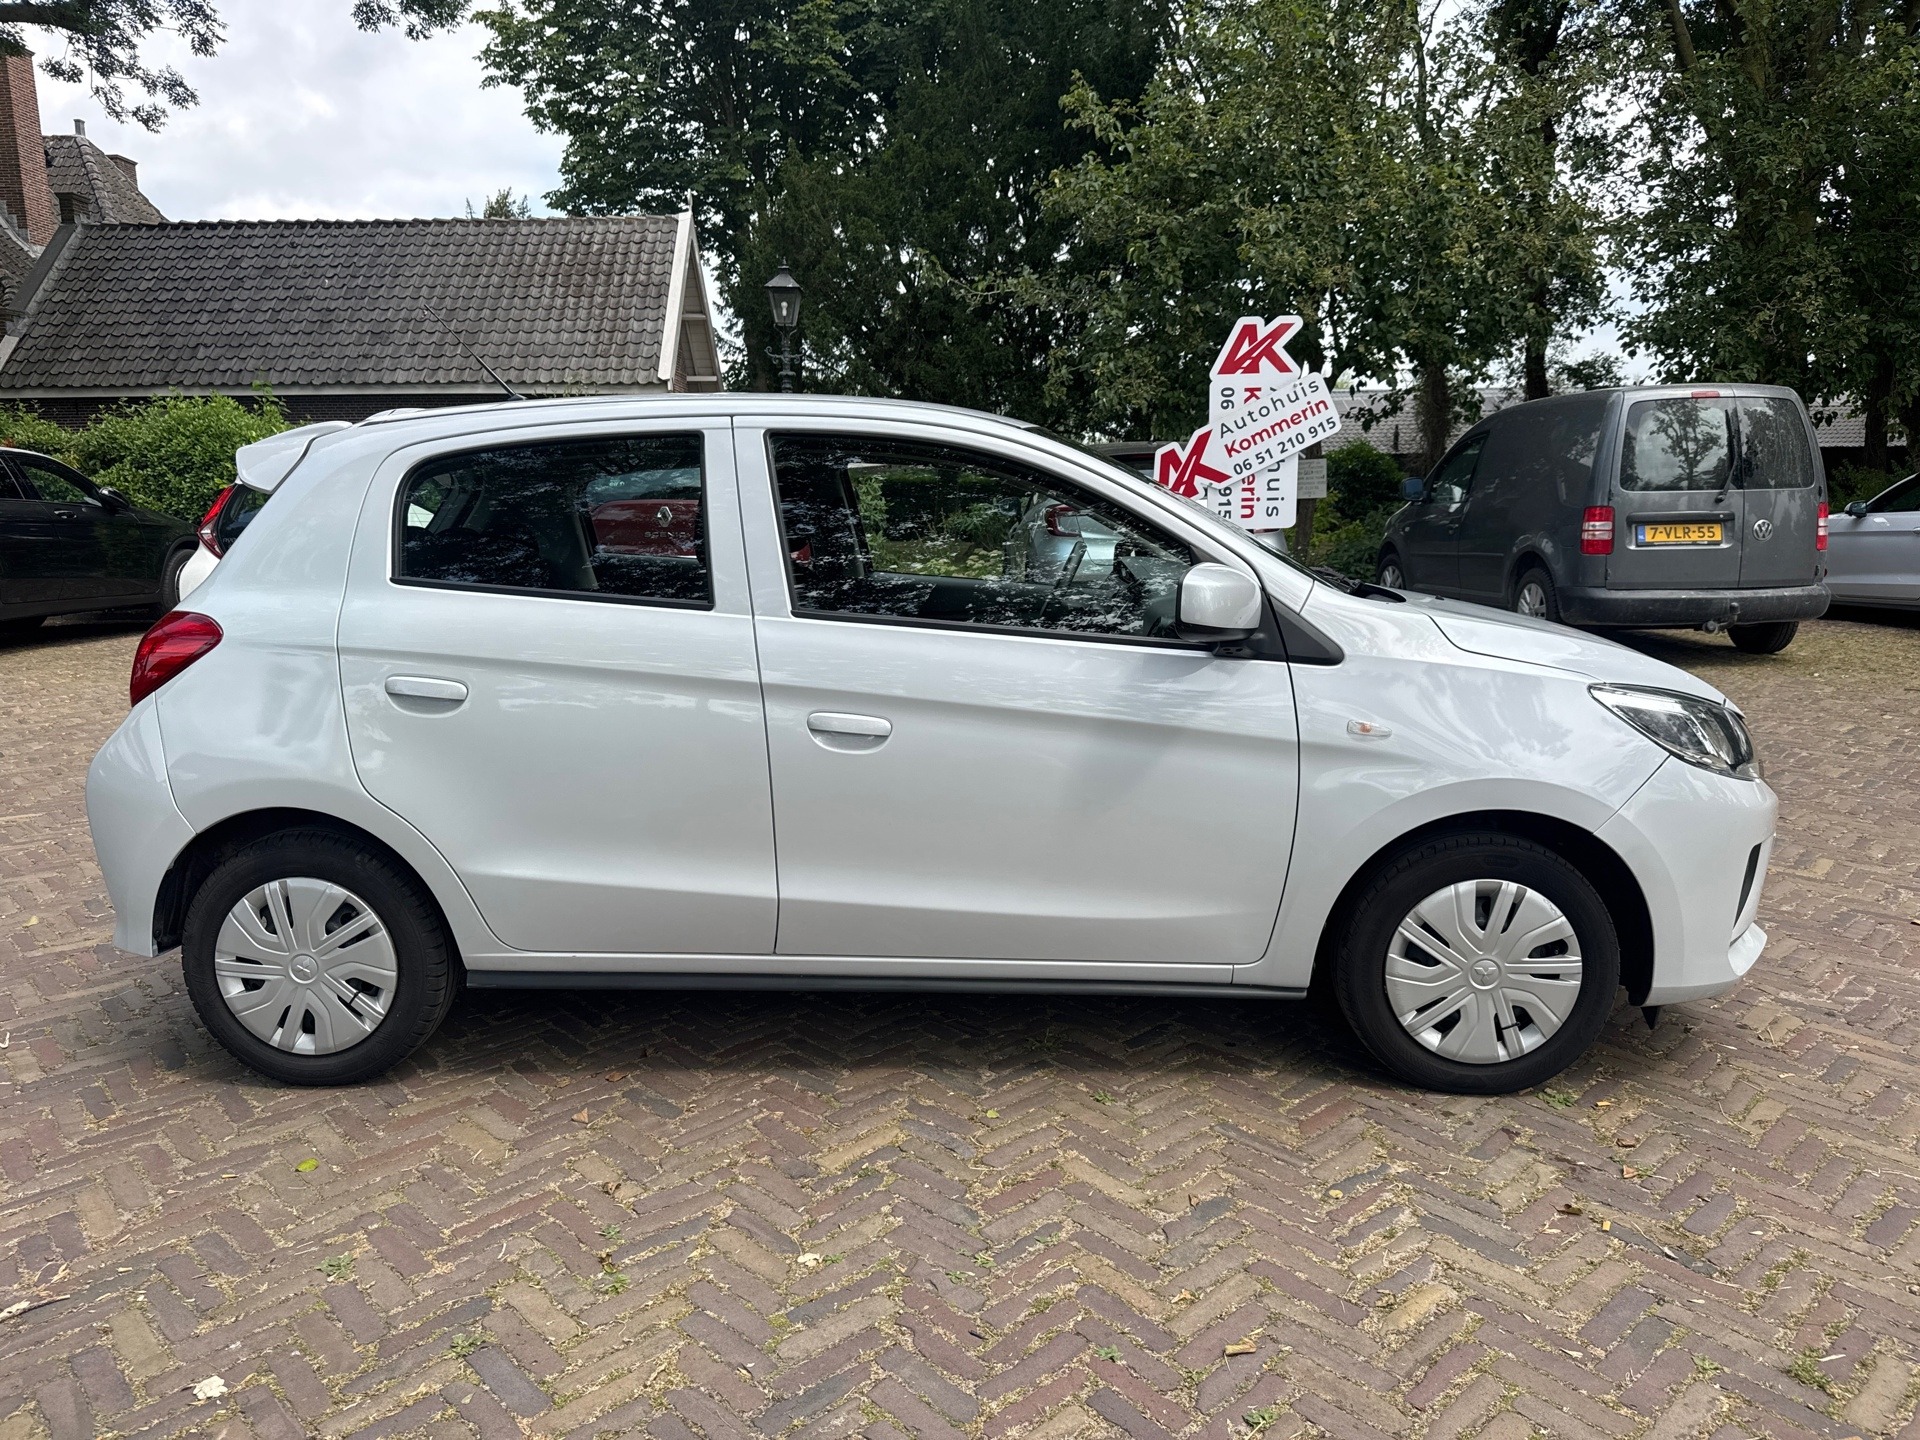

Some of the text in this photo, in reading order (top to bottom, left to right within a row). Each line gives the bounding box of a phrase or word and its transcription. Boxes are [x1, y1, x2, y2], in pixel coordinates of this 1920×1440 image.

[1220, 380, 1319, 439] Autohuis
[1224, 399, 1329, 458] Kommerin
[1233, 417, 1336, 475] 06 51 210 915
[1650, 526, 1716, 539] 7-VLR-55
